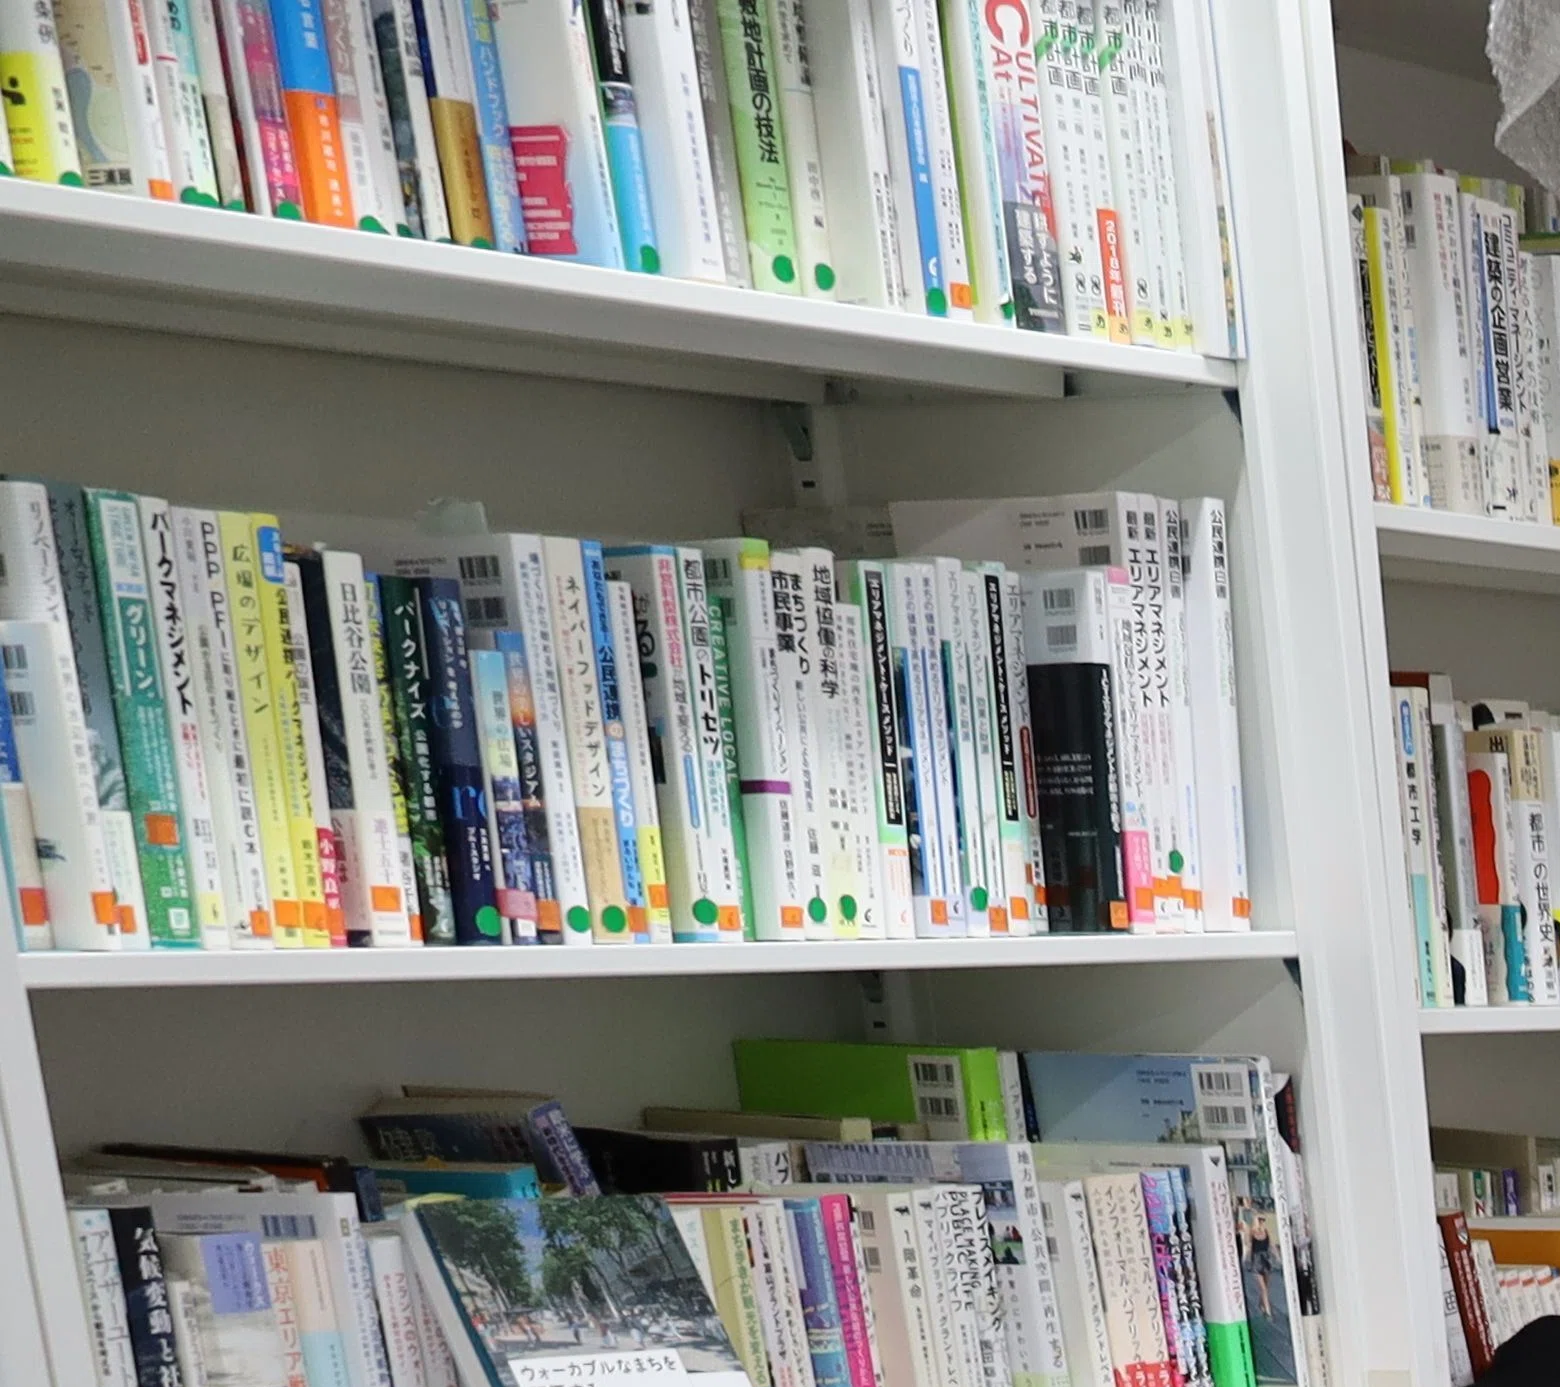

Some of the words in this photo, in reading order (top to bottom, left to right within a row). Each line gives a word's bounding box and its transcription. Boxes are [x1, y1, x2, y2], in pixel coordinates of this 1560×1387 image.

[150, 510, 195, 717] パークマネジメント
[772, 569, 797, 653] 市民事業
[1210, 509, 1227, 599] 公民連携白書
[339, 581, 372, 697] 日比谷公園
[565, 574, 605, 798] ネイバーフッドデザイン
[814, 564, 842, 699] 地域協働の科学
[1129, 548, 1153, 708] エリアマネジメント
[1146, 549, 1170, 707] エリアマネジメント
[1406, 762, 1422, 846] 都市工学
[519, 1355, 677, 1382] ウォーカブルなまちを
